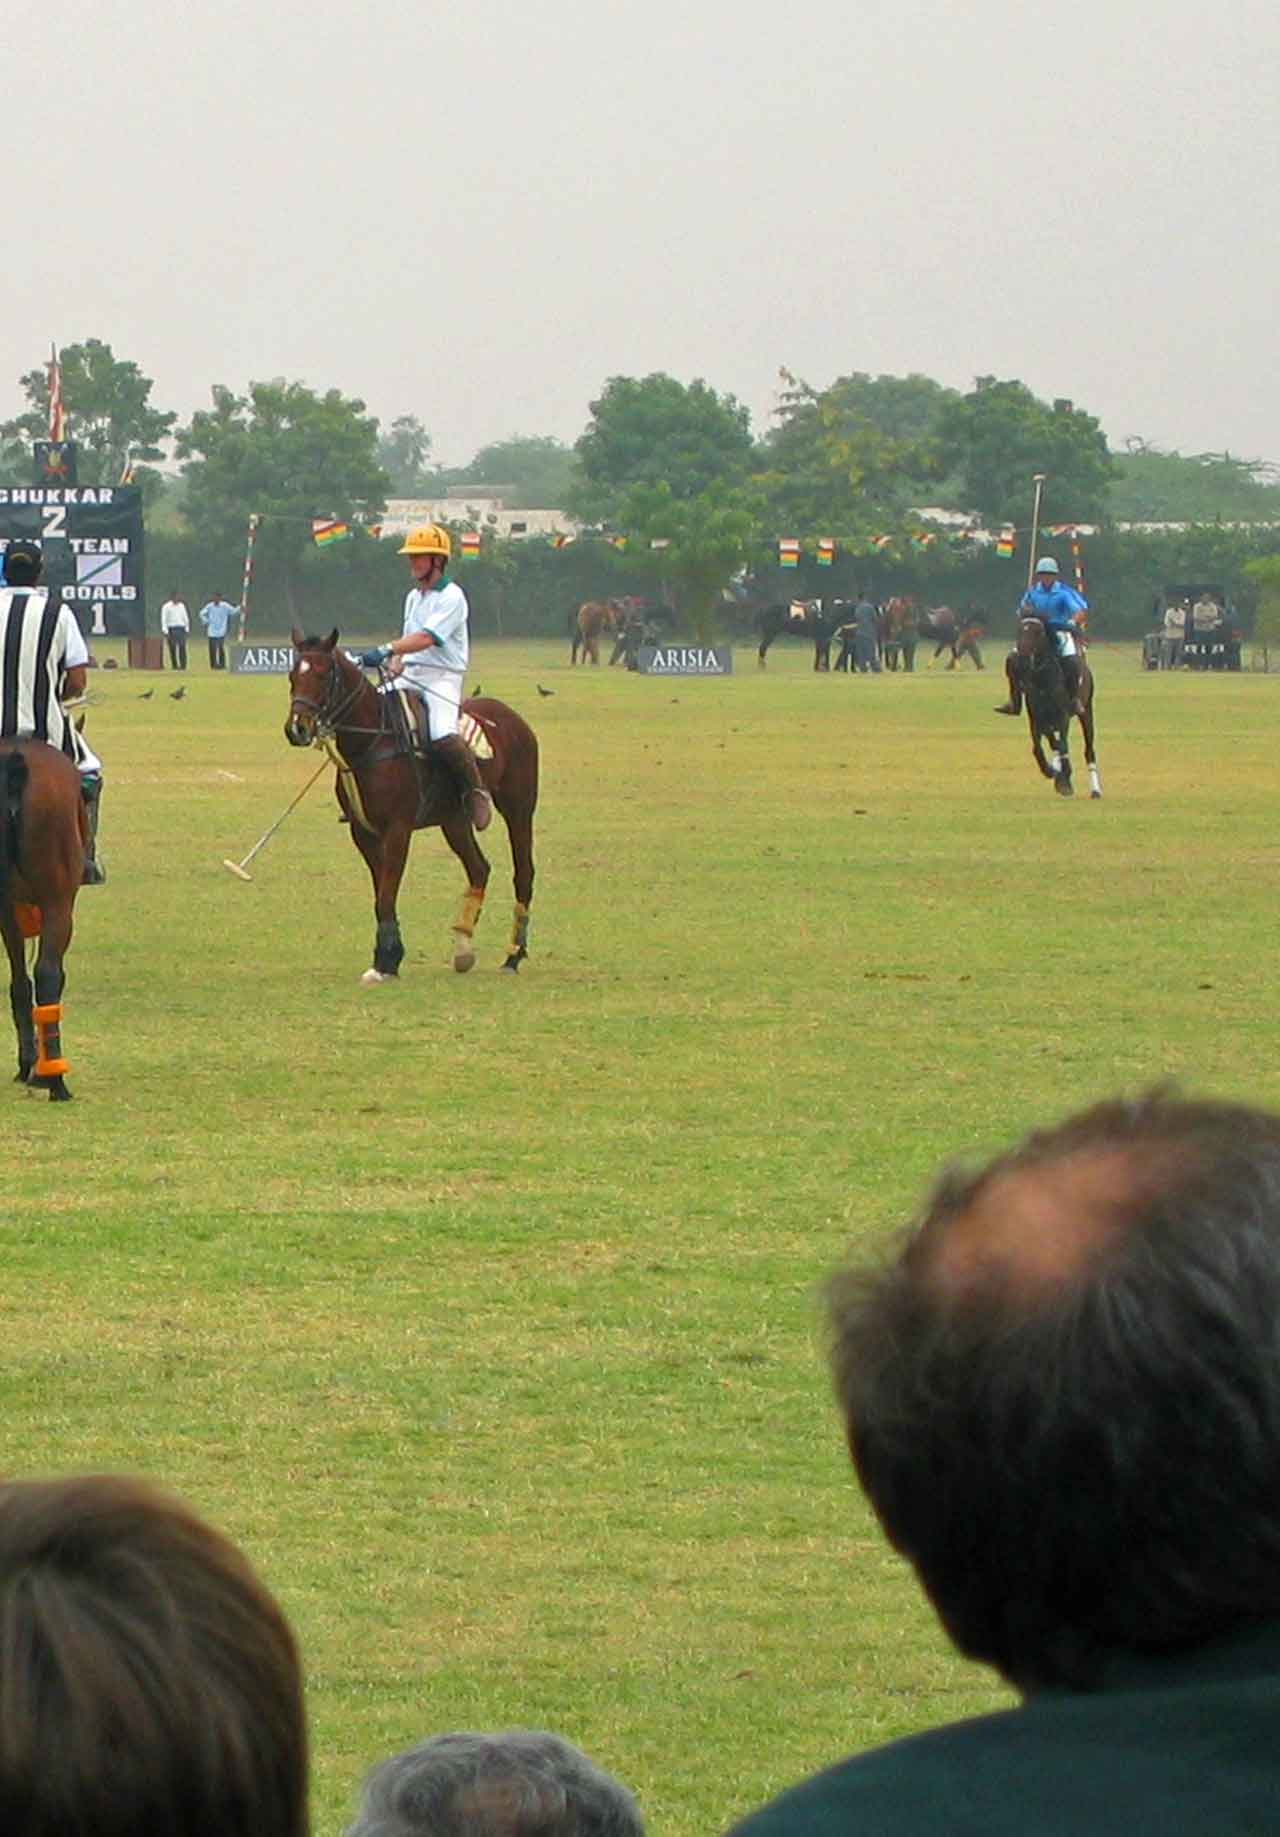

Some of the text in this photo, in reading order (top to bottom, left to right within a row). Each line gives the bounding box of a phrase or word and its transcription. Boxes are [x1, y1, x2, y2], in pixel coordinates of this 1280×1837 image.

[41, 505, 67, 538] 2
[69, 538, 129, 553] TEAM
[61, 586, 137, 600] GOALS
[91, 602, 107, 635] 1
[243, 648, 296, 665] ARISI
[652, 649, 718, 667] ARISIA
